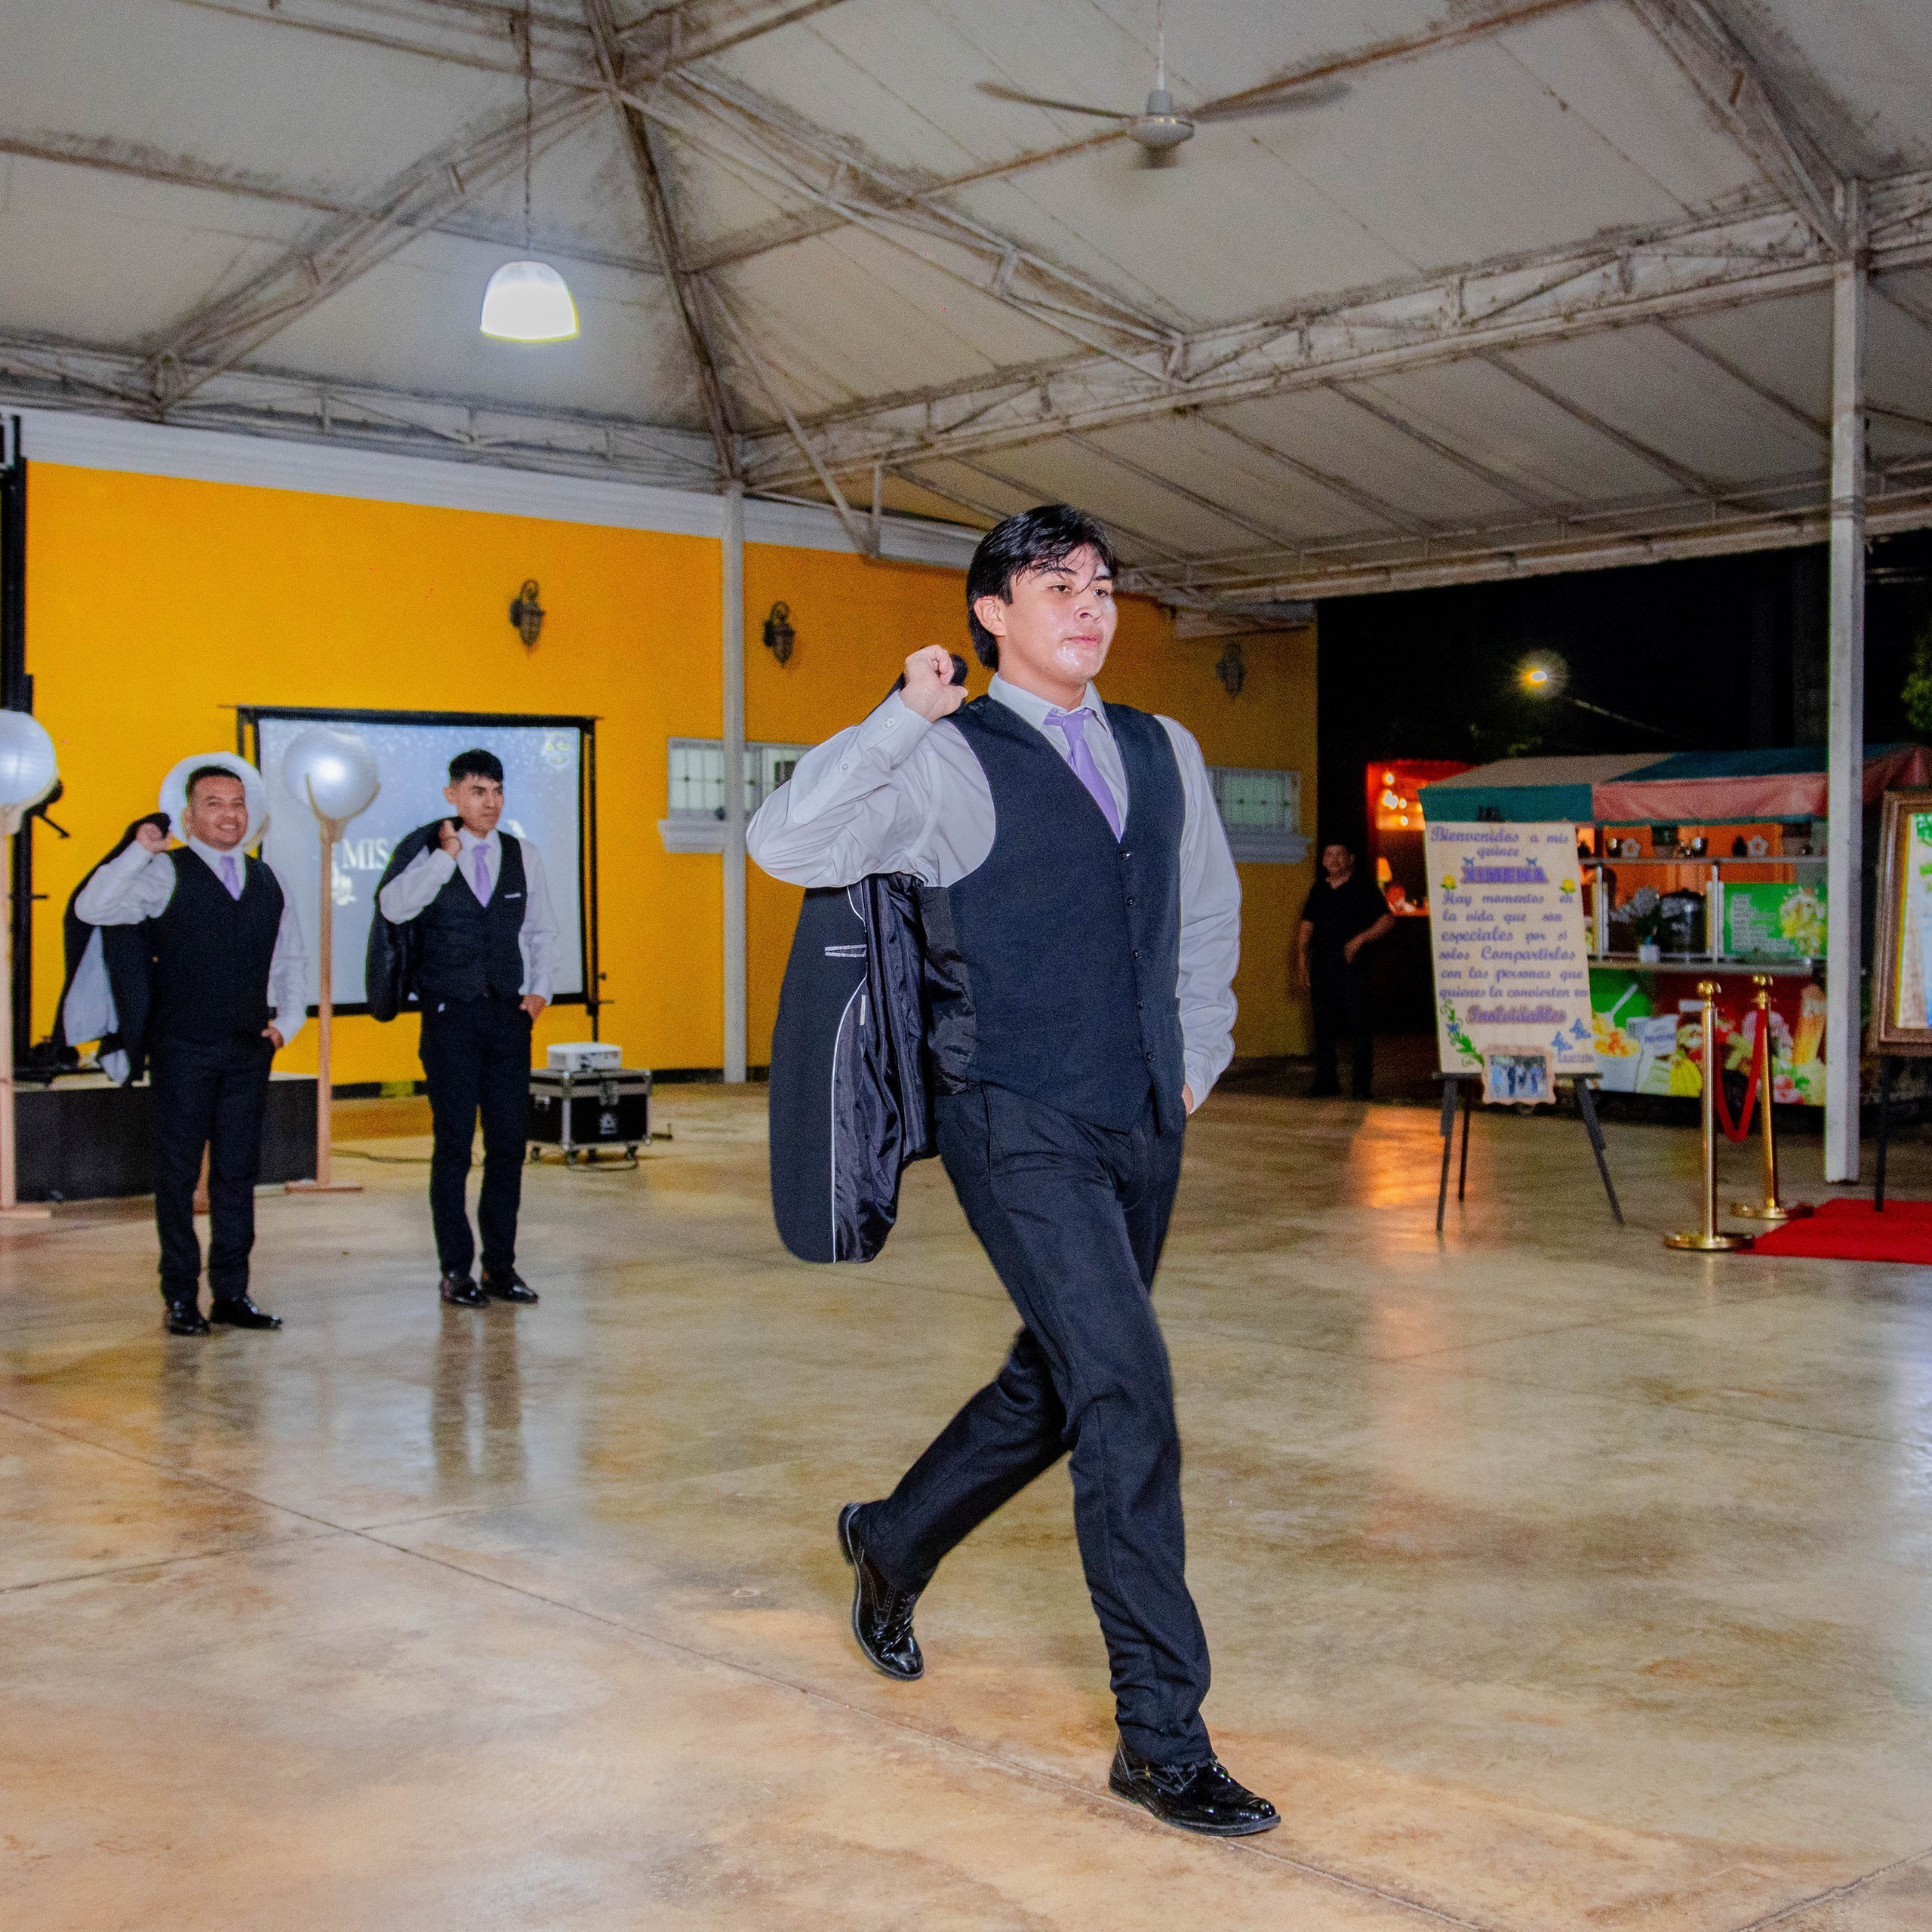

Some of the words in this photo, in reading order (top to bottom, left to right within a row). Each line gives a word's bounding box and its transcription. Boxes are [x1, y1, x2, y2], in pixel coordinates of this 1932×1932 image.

[1431, 826, 1520, 842] Bienvenidos
[1531, 835, 1540, 843] a
[1547, 834, 1569, 844] mis
[1477, 846, 1519, 859] quince
[1461, 866, 1549, 884] XIMENA
[1482, 894, 1544, 903] momentos
[1443, 909, 1457, 922] la
[1466, 910, 1494, 922] vida
[1504, 913, 1527, 924] que
[1543, 913, 1562, 922] son
[1441, 925, 1513, 943] especiales
[1526, 933, 1546, 944] por
[1441, 971, 1463, 979] con
[1469, 966, 1489, 979] las
[1496, 969, 1551, 983] personas
[1489, 985, 1503, 998] la
